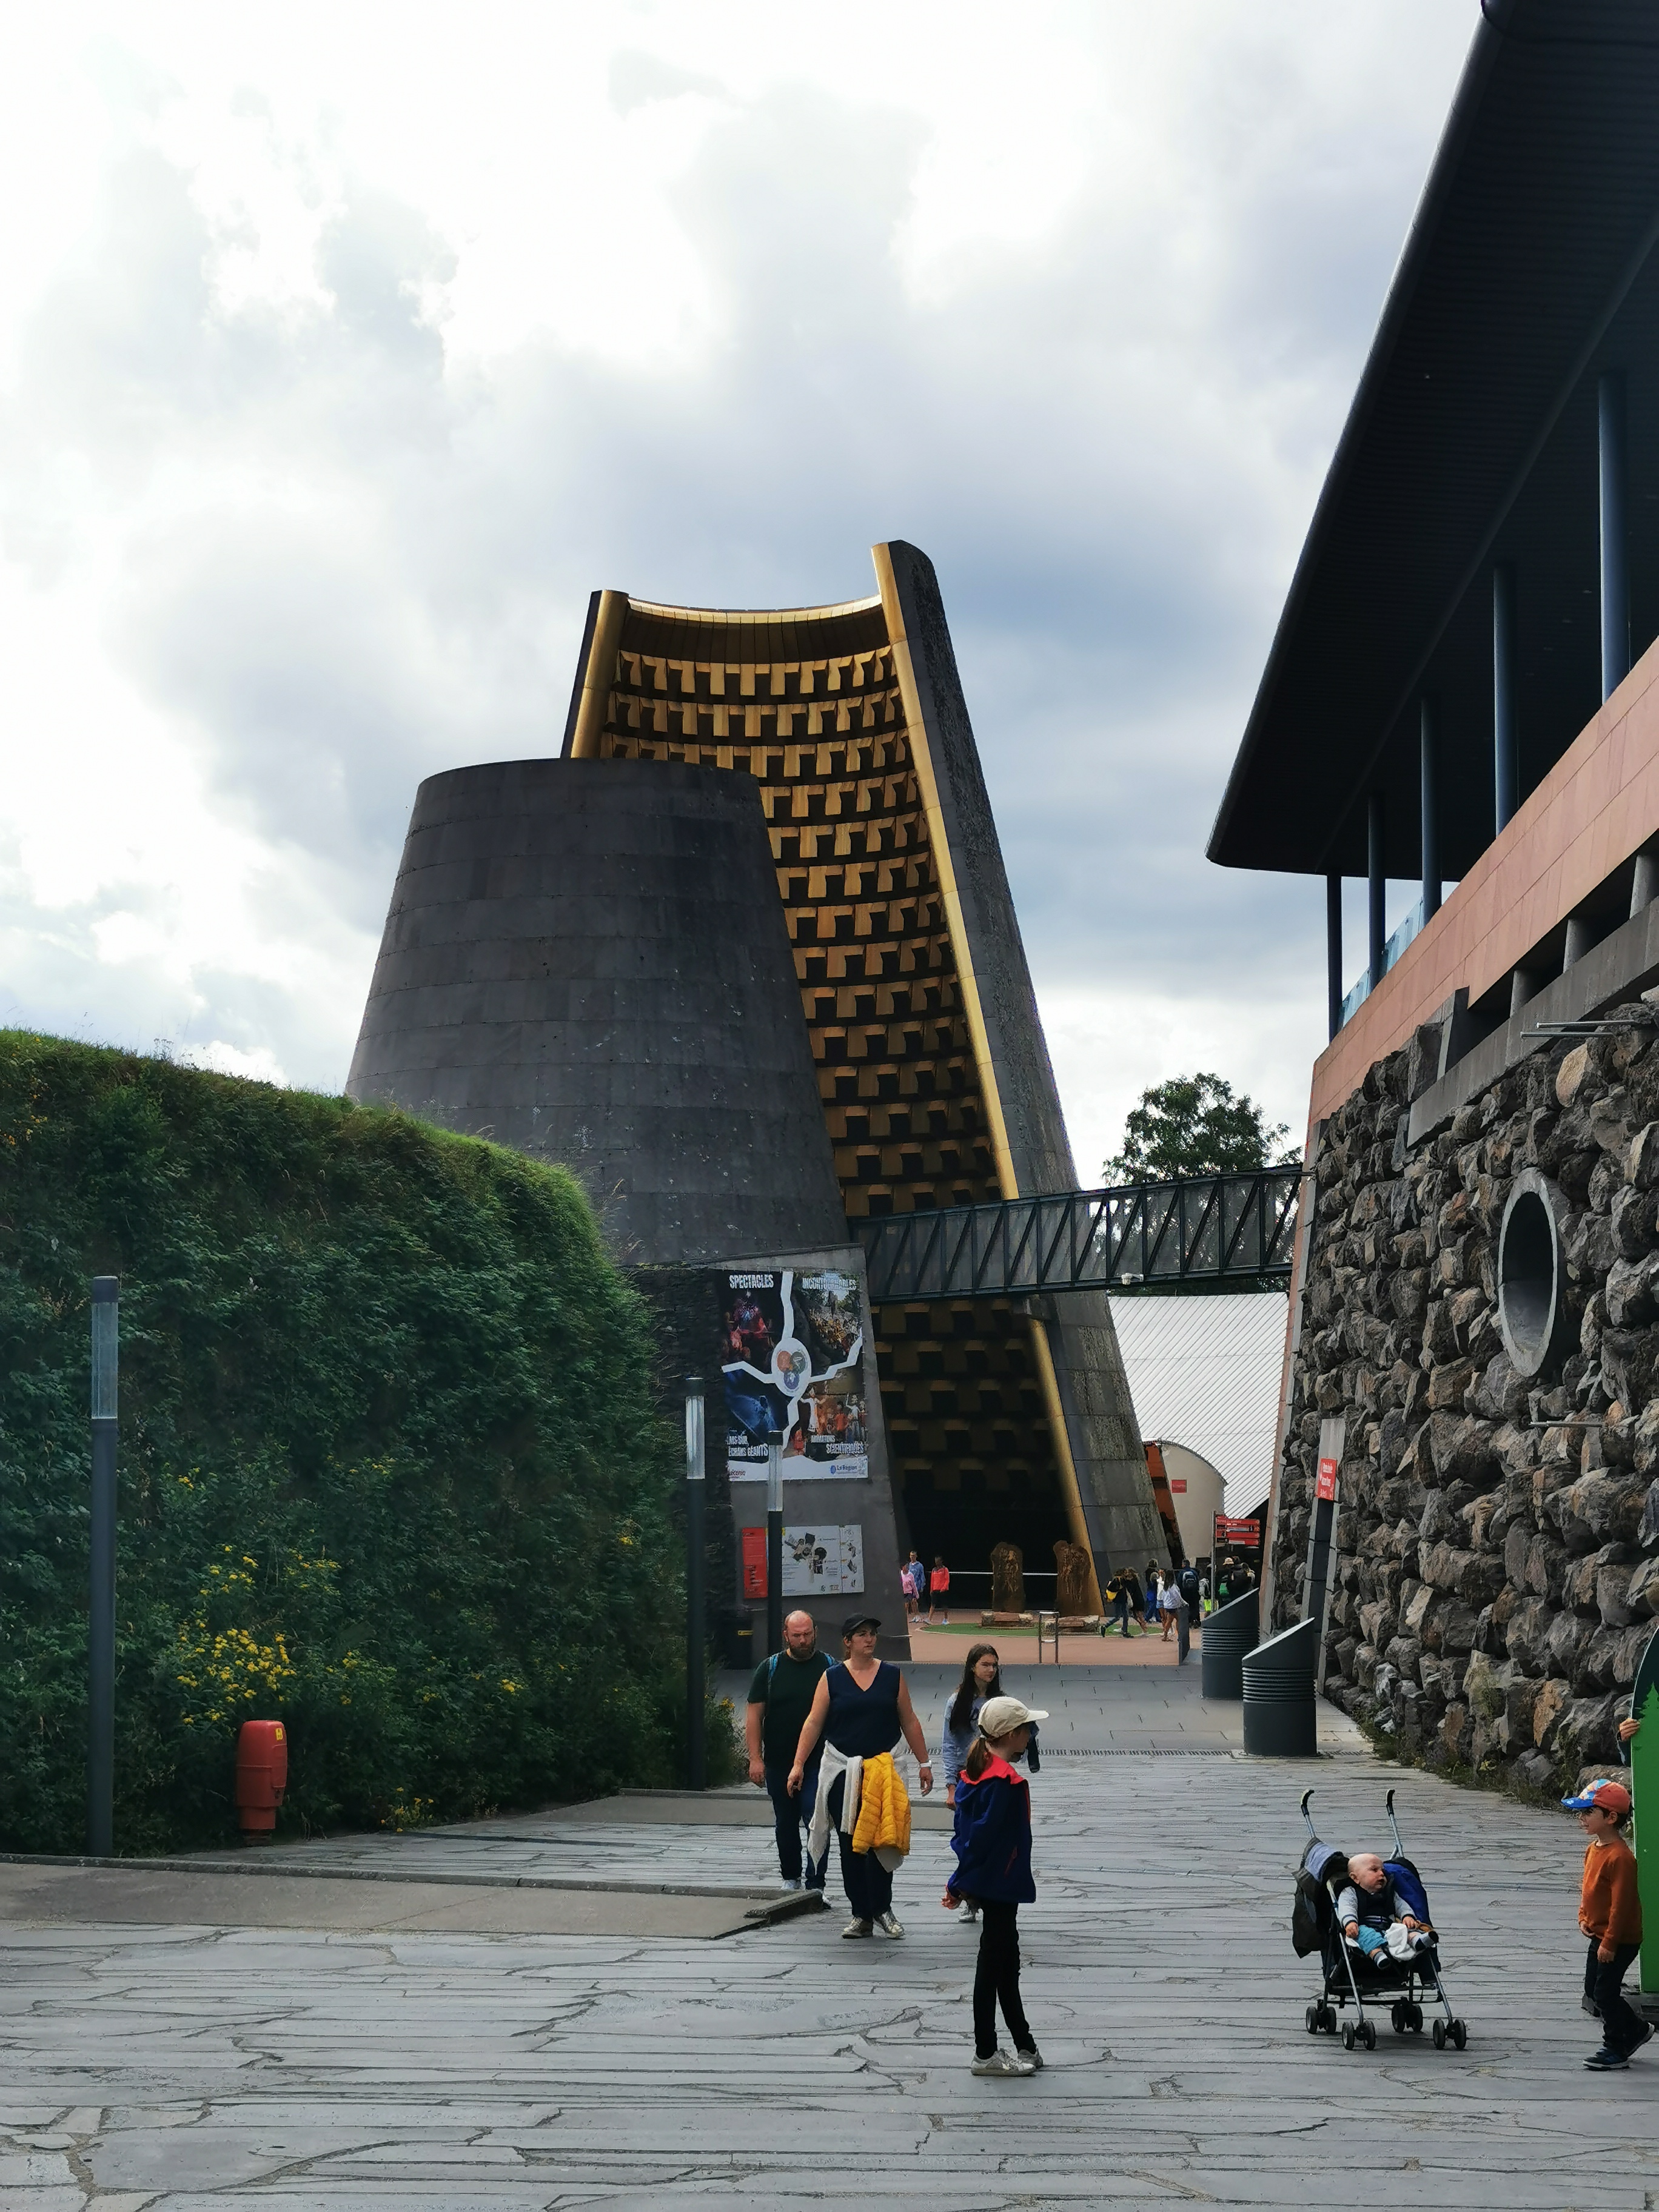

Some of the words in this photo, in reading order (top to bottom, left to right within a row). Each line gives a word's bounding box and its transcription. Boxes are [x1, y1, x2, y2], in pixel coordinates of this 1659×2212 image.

[729, 1275, 774, 1289] SPECTACLES
[802, 1277, 856, 1290] INCONTOURNABLES
[747, 1443, 768, 1456] GÉANTS
[826, 1441, 864, 1455] SCIENTIFIQUES
[843, 1463, 857, 1472] Région
